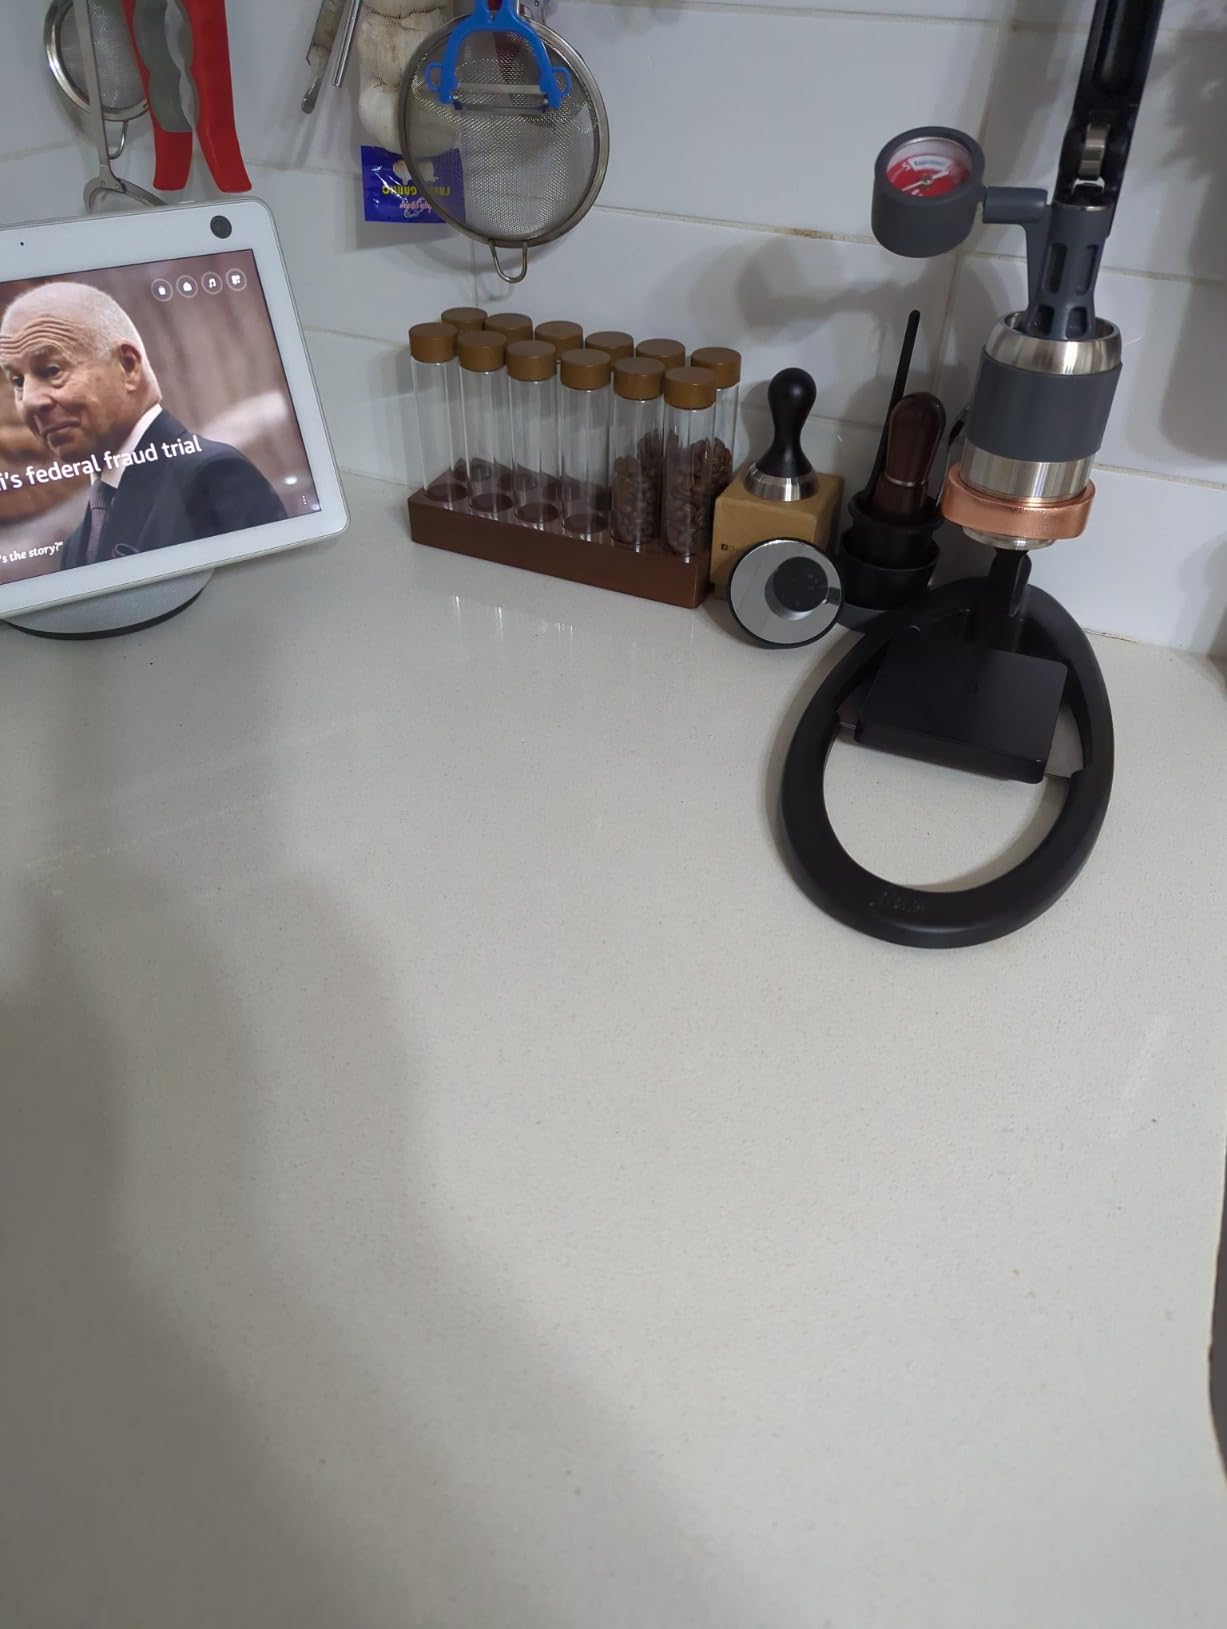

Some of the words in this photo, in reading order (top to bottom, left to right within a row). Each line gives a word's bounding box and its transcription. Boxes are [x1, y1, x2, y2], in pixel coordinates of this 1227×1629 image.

[0, 471, 23, 492] i's
[25, 454, 101, 485] federal
[104, 443, 158, 470] fraud
[161, 435, 202, 459] trial
[9, 550, 27, 562] the
